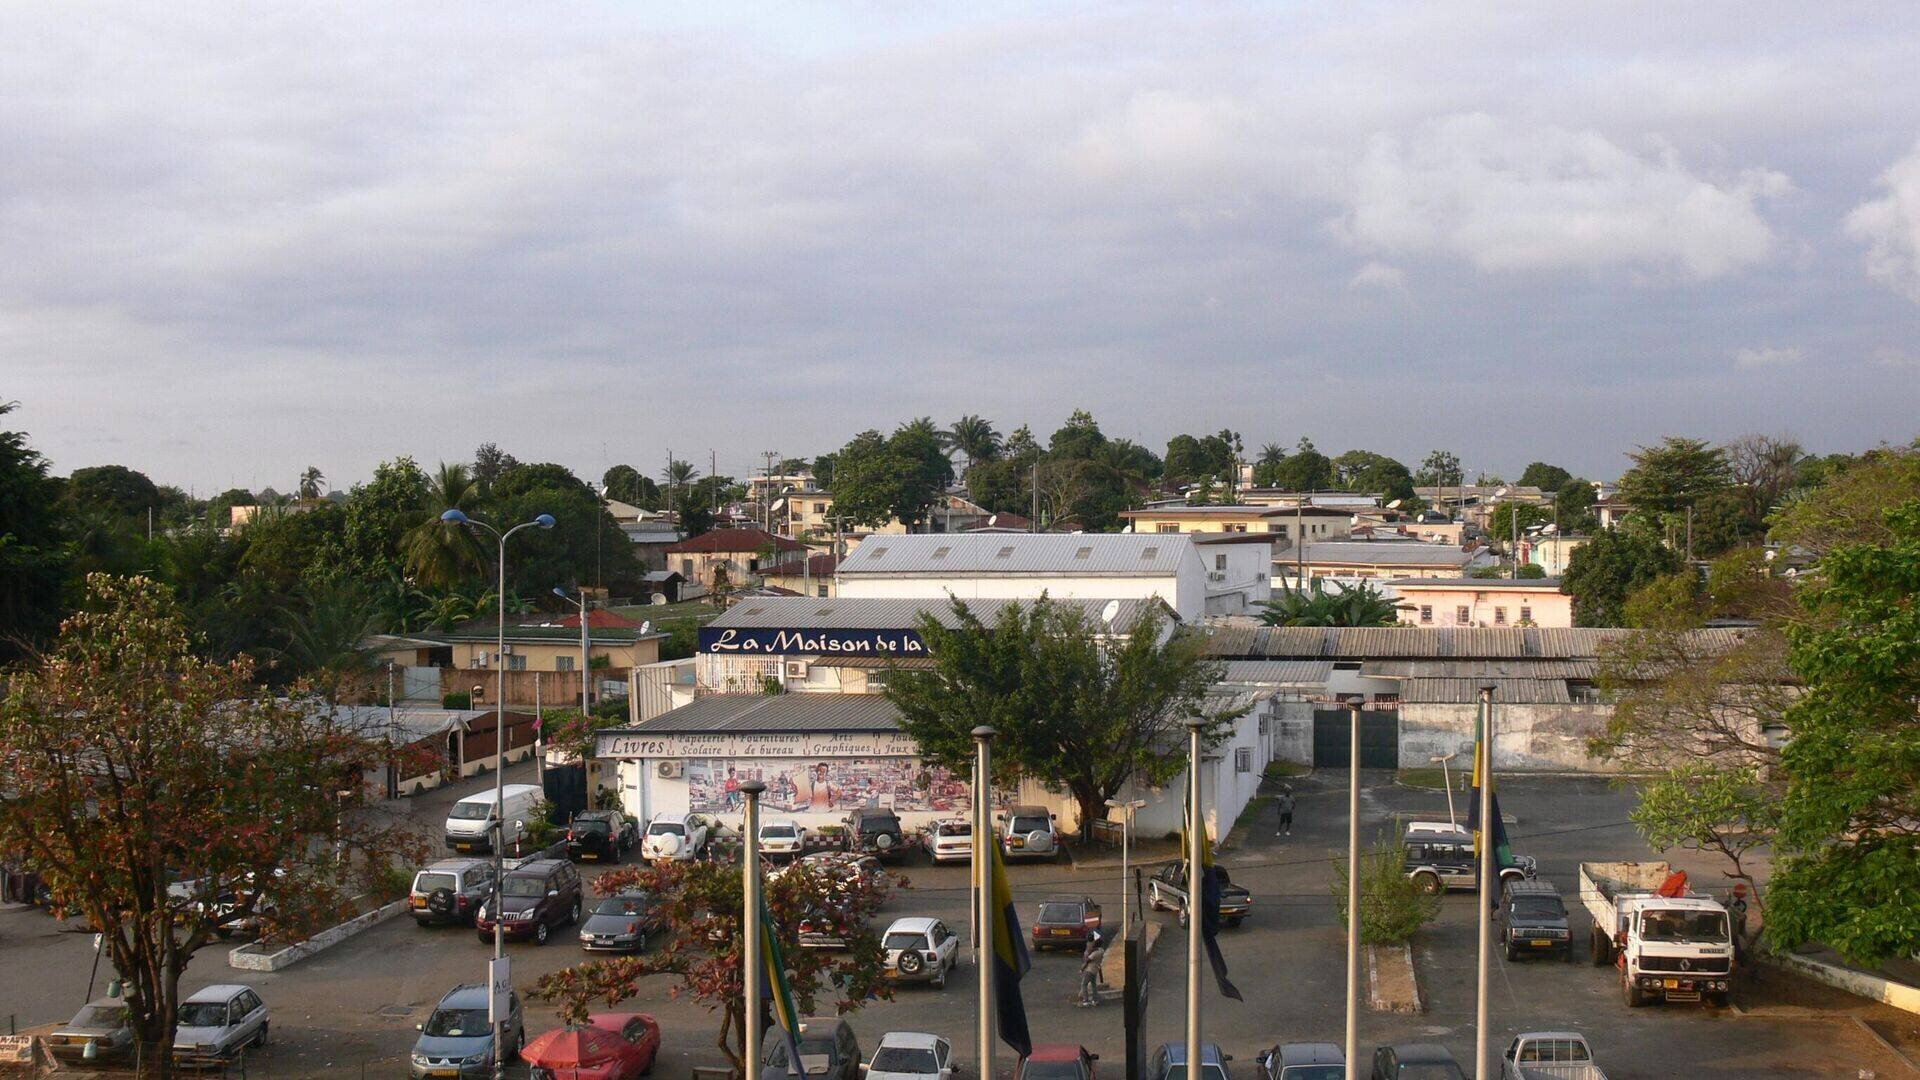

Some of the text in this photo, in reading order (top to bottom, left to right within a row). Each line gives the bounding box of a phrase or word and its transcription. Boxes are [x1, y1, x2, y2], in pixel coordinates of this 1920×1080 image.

[711, 629, 759, 652] La
[765, 630, 871, 652] Maison
[875, 635, 897, 651] de
[904, 635, 922, 651] la
[678, 734, 726, 745] Papeterie
[739, 733, 800, 743] Fournitures
[830, 732, 853, 742] Arts
[610, 737, 665, 754] Livres
[680, 745, 722, 756] Scolaire
[744, 744, 795, 755] de bureau
[813, 743, 871, 755] Graphiques
[884, 744, 909, 754] Jeux
